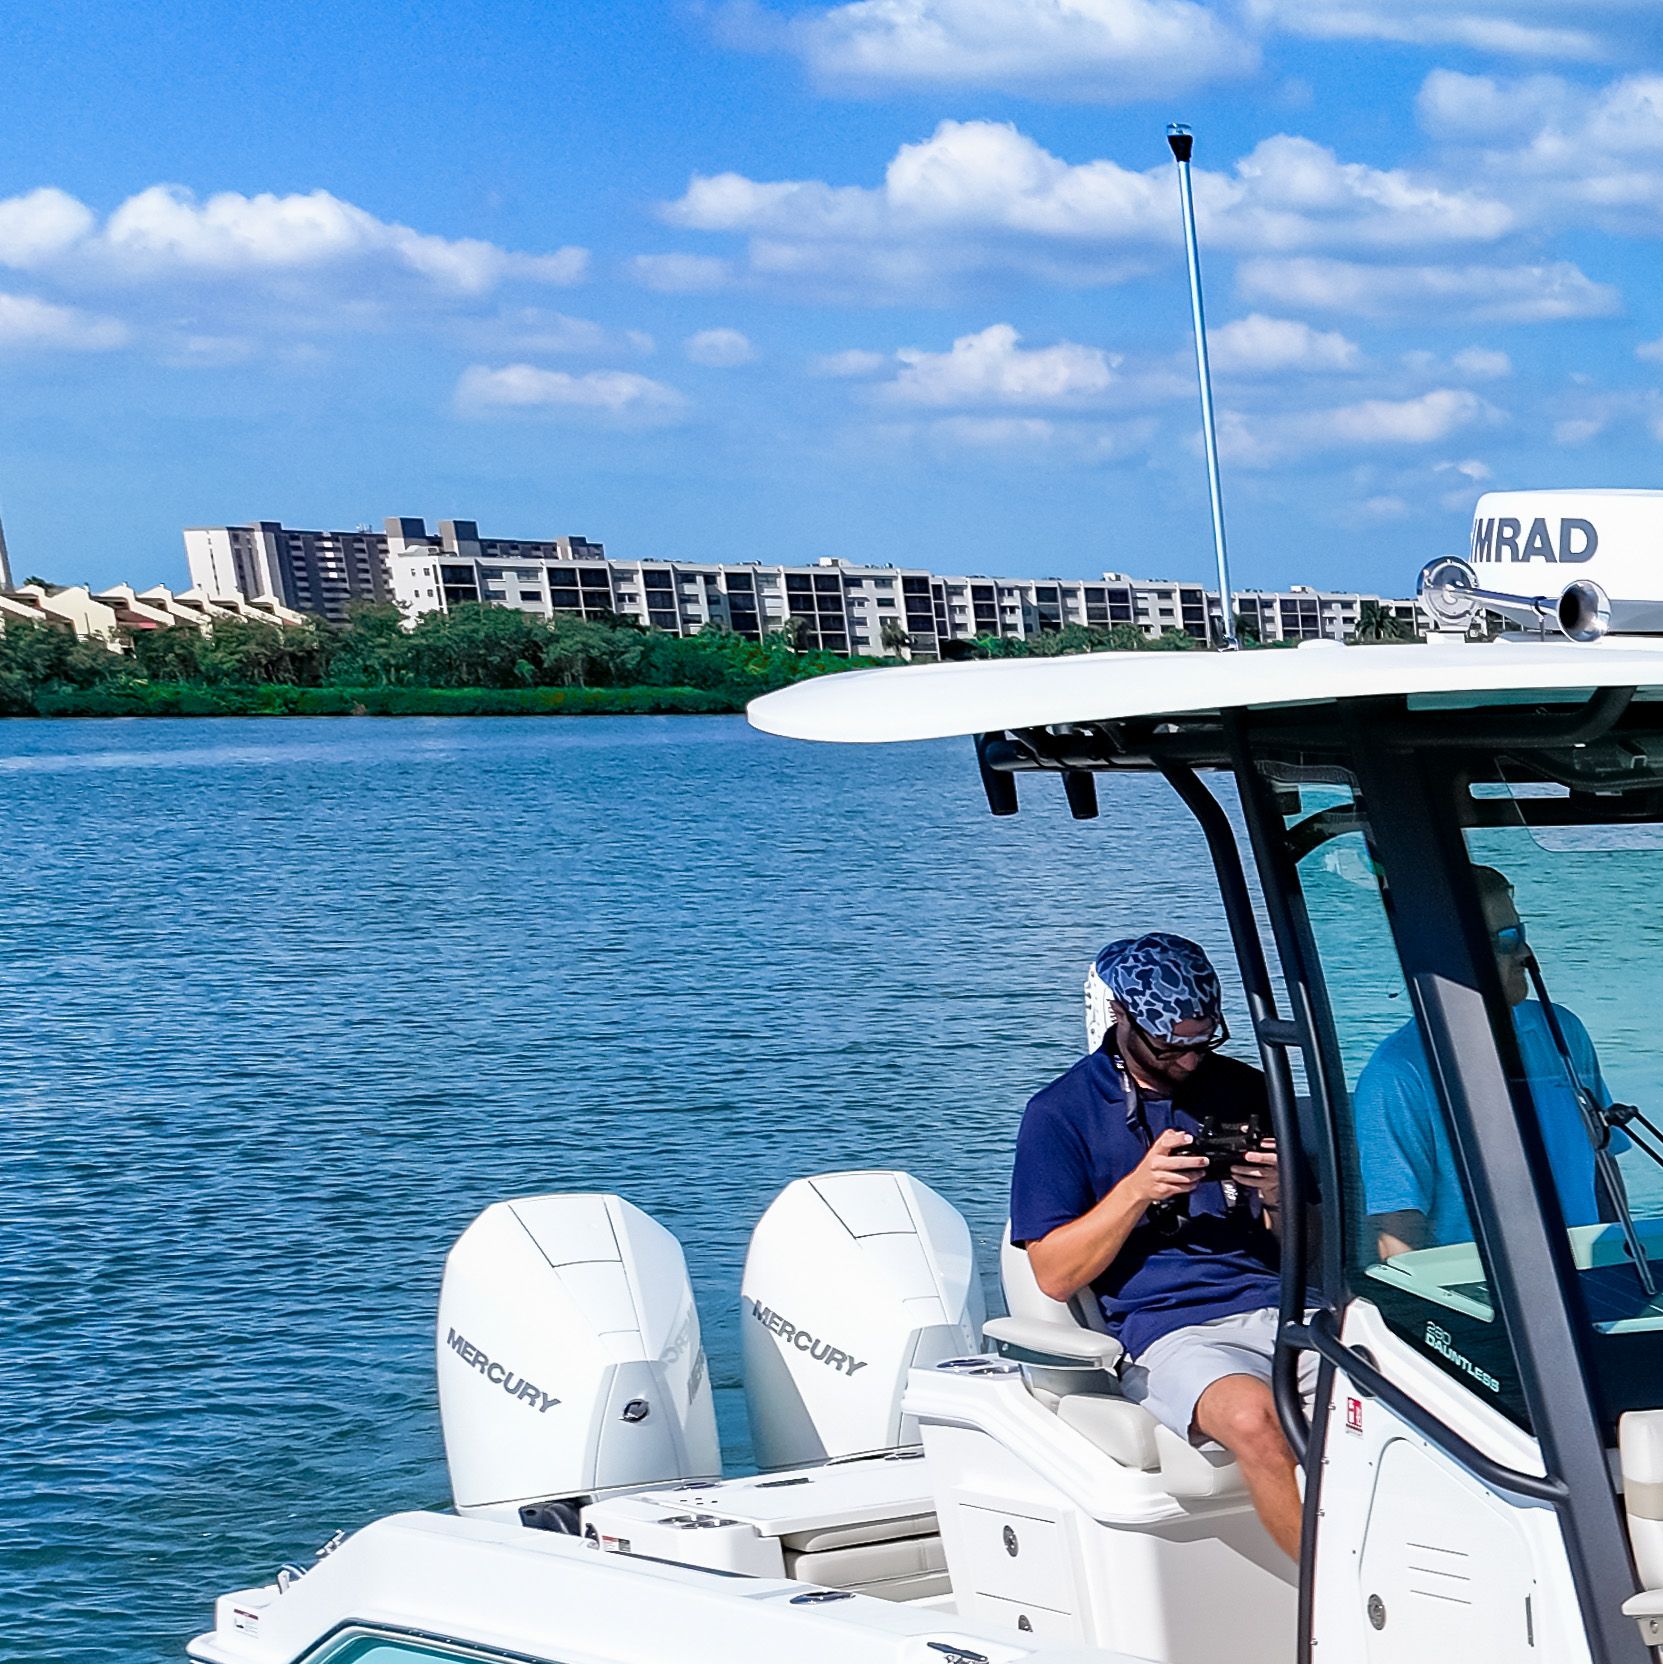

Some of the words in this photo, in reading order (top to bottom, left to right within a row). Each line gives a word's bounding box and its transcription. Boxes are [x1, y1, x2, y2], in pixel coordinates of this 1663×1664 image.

[1470, 517, 1599, 563] IMRAD
[446, 1326, 562, 1413] MERCURY
[752, 1299, 868, 1377] MERCURY
[1425, 1332, 1500, 1393] DAUNTLESS
